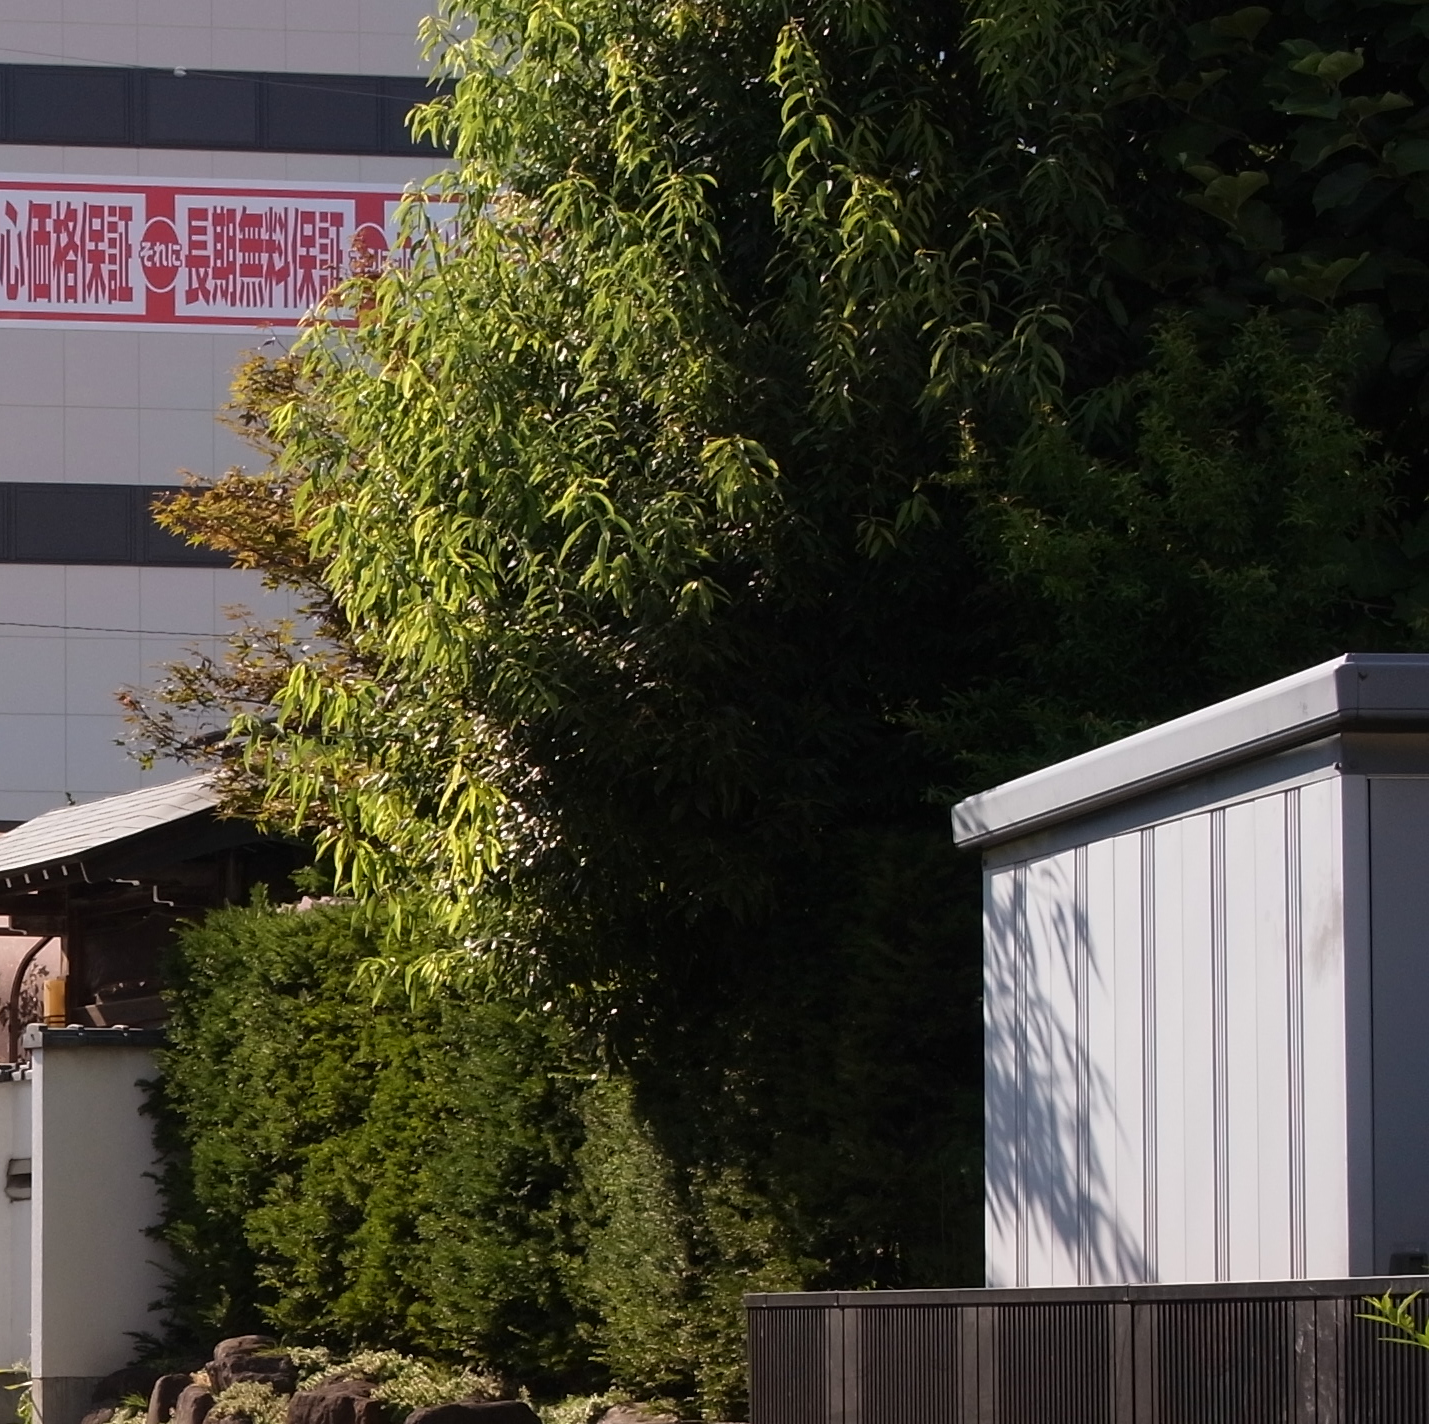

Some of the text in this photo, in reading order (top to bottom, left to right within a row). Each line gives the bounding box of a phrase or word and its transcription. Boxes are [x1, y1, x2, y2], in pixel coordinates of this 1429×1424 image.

[139, 241, 183, 268] それに
[185, 206, 345, 308] 長期無料保証
